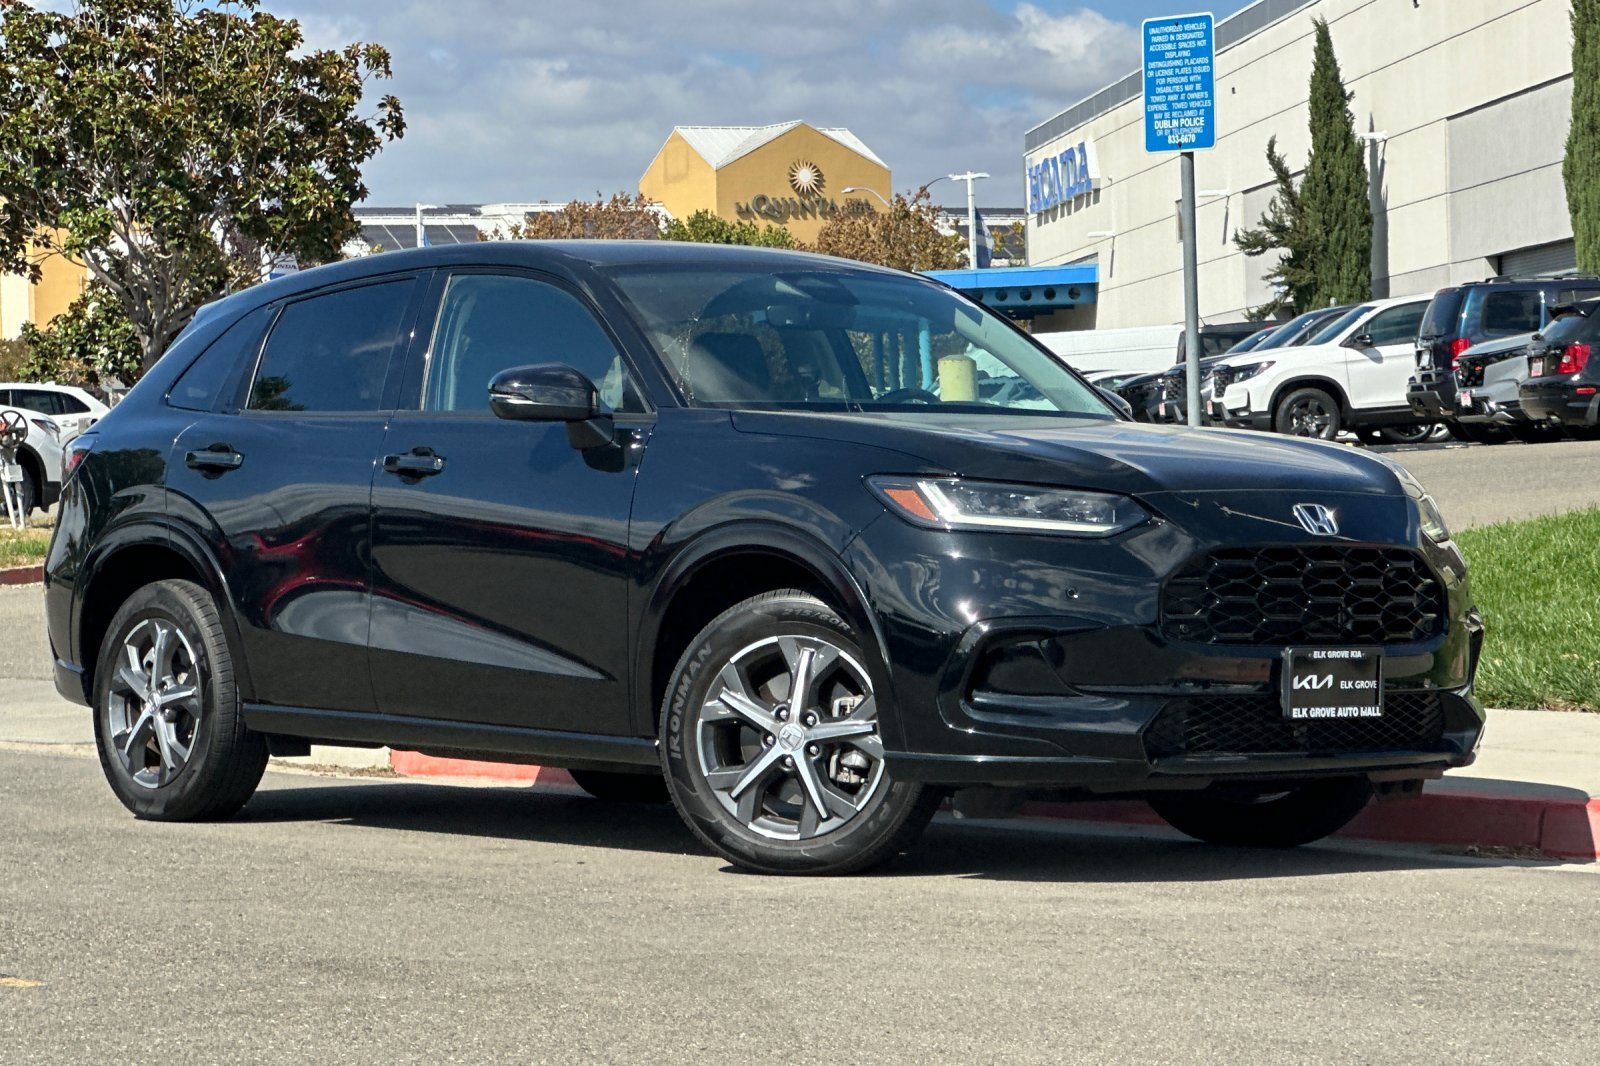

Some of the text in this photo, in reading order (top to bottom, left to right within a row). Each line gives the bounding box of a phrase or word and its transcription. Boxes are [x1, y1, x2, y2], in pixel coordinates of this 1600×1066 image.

[1149, 25, 1182, 34] UNAUTHORIZED
[1176, 32, 1204, 40] DESIGNATED
[1150, 43, 1176, 51] ACCESSIBLE
[1165, 50, 1190, 58] DISPLAYING
[1148, 57, 1208, 69] DISTINGUISHING PLACARDS
[1156, 85, 1183, 93] DISABILITIES
[1154, 117, 1204, 129] DUBLIN POLICE
[1168, 134, 1196, 144] 833-6670
[1028, 142, 1092, 214] HONDA
[752, 194, 838, 218] QUINTA
[1293, 674, 1377, 689] KIA ELK GROVE
[669, 641, 712, 760] IRONMAN
[1292, 707, 1381, 718] ELK GROVE AUTO MALL
